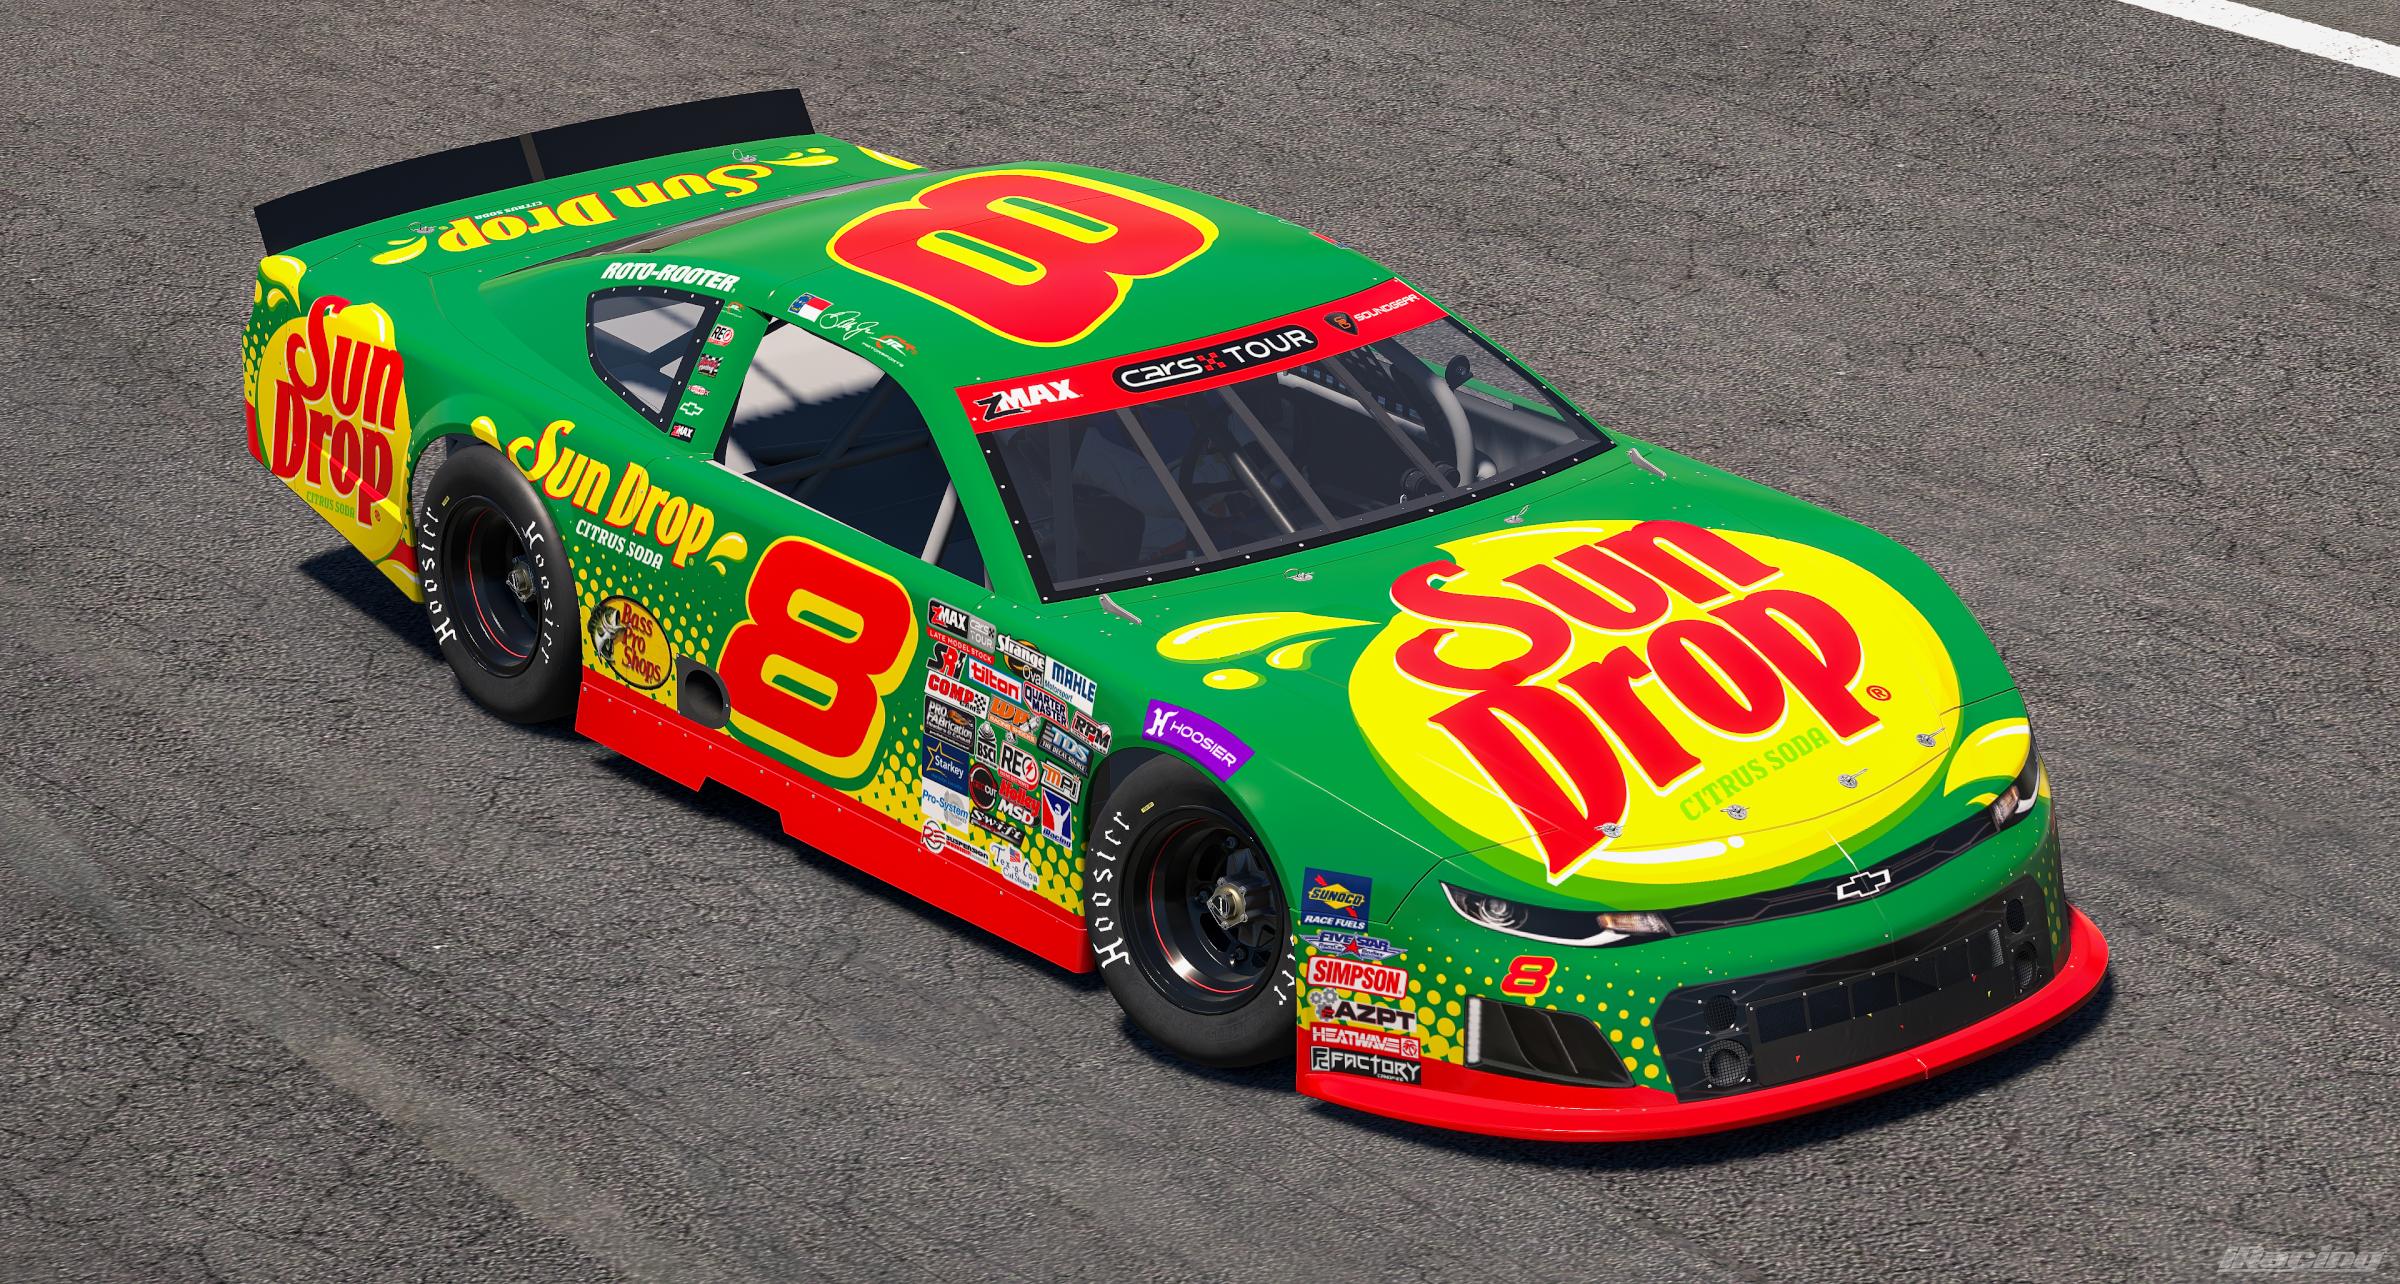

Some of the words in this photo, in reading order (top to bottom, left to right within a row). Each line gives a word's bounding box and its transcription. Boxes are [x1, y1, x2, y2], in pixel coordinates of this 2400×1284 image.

[611, 163, 774, 208] Sun
[438, 192, 618, 252] Drop
[826, 169, 1219, 347] 8
[600, 262, 741, 292] ROTO-ROOTER
[1354, 294, 1420, 322] SOUNDGEAR
[1222, 328, 1314, 364] TOUR
[285, 294, 404, 435] Sun
[270, 380, 395, 528] Drop
[507, 420, 611, 515] Sun
[603, 462, 715, 569] Drop
[576, 519, 626, 554] CITRUS
[626, 541, 663, 570] SODA
[622, 602, 653, 638] Bass
[1390, 520, 1782, 695] Sun
[622, 627, 646, 655] Pro
[930, 630, 946, 642] LATE
[948, 637, 970, 652] MODEL
[971, 647, 992, 663] STOCK
[970, 630, 993, 649] TOUR
[996, 634, 1046, 672] Strange
[622, 646, 661, 684] Shops
[716, 535, 919, 779] 8
[928, 674, 975, 704] COMP
[971, 662, 1019, 700] tilton
[1022, 665, 1044, 687] Oval
[1052, 662, 1096, 703] MAHLE
[929, 701, 948, 717] PRO
[1025, 686, 1066, 714] QUARTER
[1032, 700, 1067, 727] MASTER
[1170, 720, 1237, 767] HOOSIER
[1428, 590, 1883, 886] Drop
[935, 755, 964, 779] Starkey
[1679, 758, 1769, 821] CITRUS
[1764, 727, 1830, 770] SODA
[923, 789, 969, 819] Pro-System
[998, 799, 1034, 825] MSD
[999, 779, 1041, 817] Holley
[1043, 828, 1071, 848] iRacing
[1310, 888, 1364, 906] SUNOCO
[1304, 915, 1335, 926] RACE
[1338, 919, 1365, 930] FUELS
[1320, 932, 1354, 943] FIVE
[1357, 936, 1389, 952] STAR
[1313, 960, 1401, 994] SIMPSON
[1500, 955, 1557, 997] 8
[1335, 1001, 1415, 1031] AZPT
[1312, 1027, 1399, 1053] HEATWAVE
[1331, 1051, 1420, 1082] FACTORY
